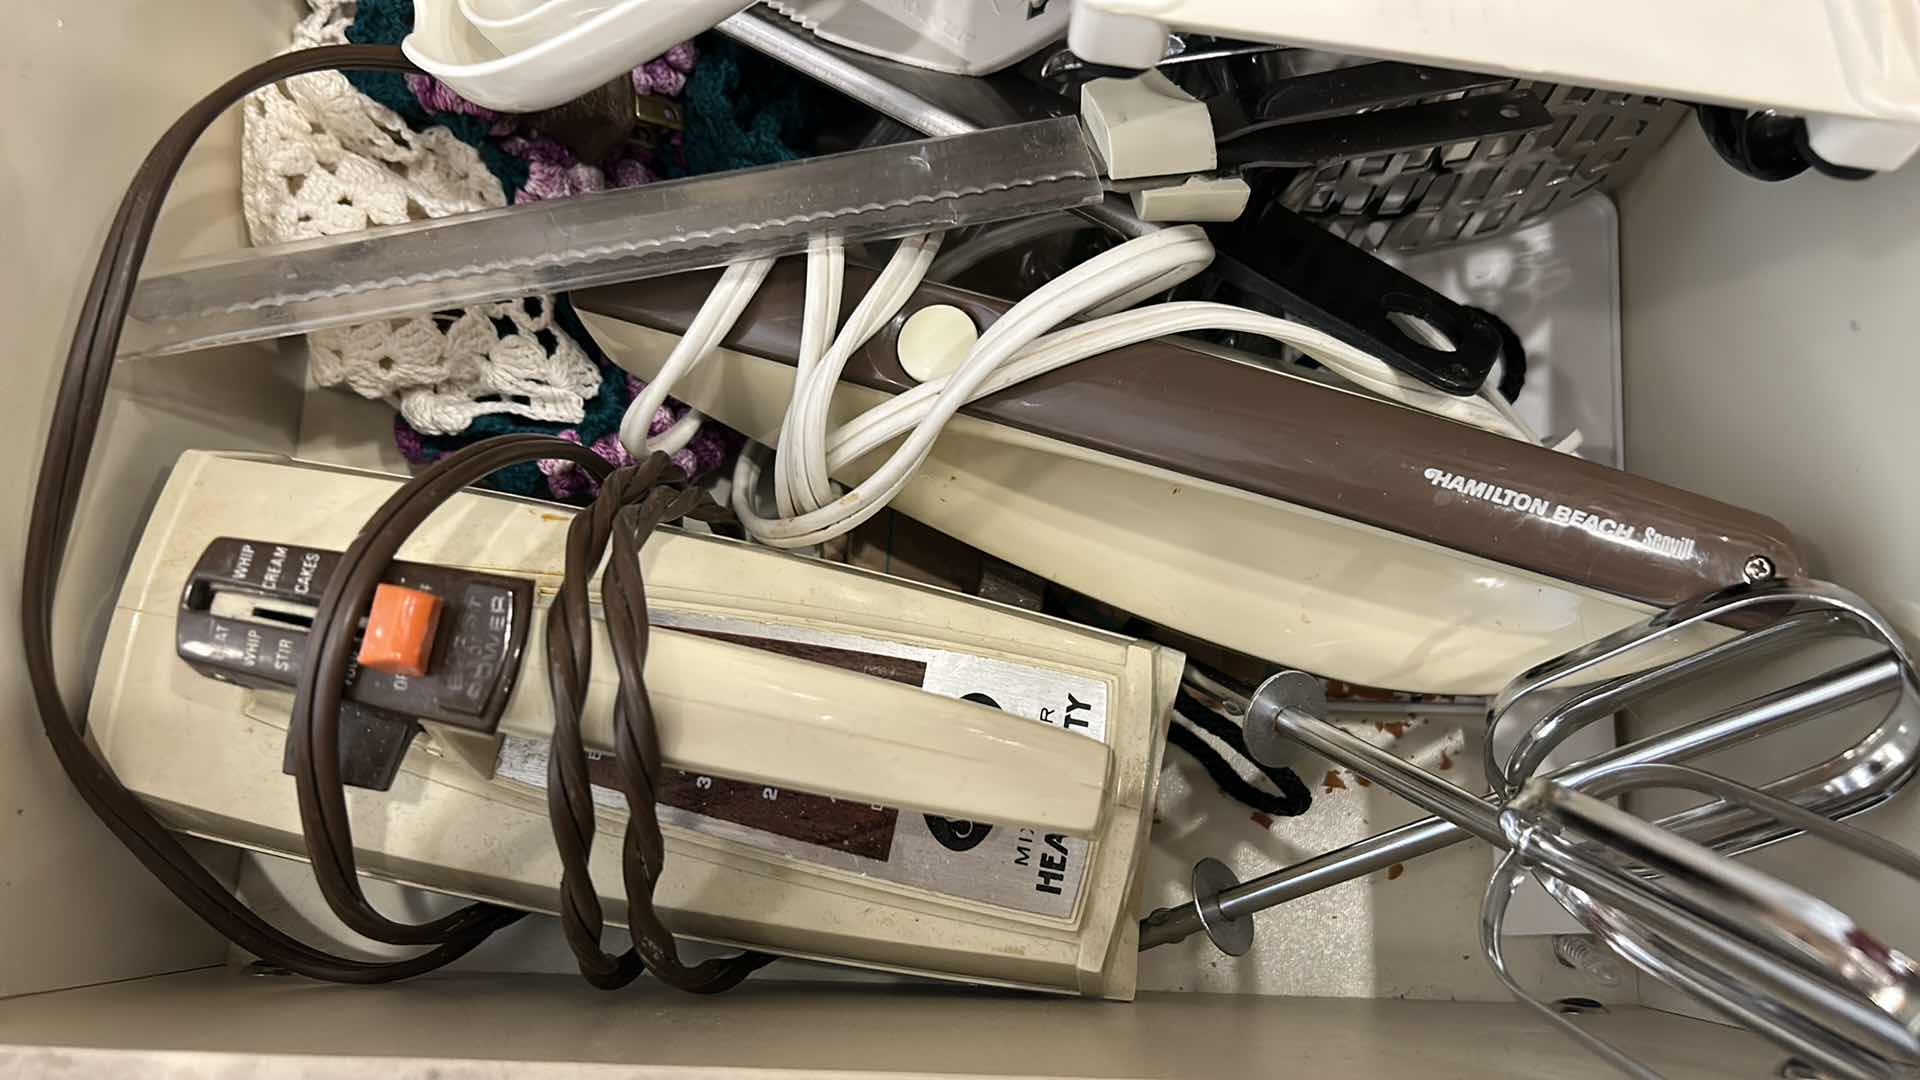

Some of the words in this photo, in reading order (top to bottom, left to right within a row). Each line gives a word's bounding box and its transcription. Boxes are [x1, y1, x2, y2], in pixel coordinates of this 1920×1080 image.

[1424, 467, 1549, 517] HAMILTON
[1552, 503, 1637, 543] BEACH
[232, 543, 256, 579] WHIP
[261, 546, 289, 590] CREAM
[294, 552, 321, 594] CAKES
[243, 629, 262, 667] WHIP
[274, 638, 294, 672] STIR
[695, 775, 712, 790] 3
[762, 787, 778, 801] 2
[1035, 832, 1069, 895] HEA
[1063, 692, 1092, 729] TY
